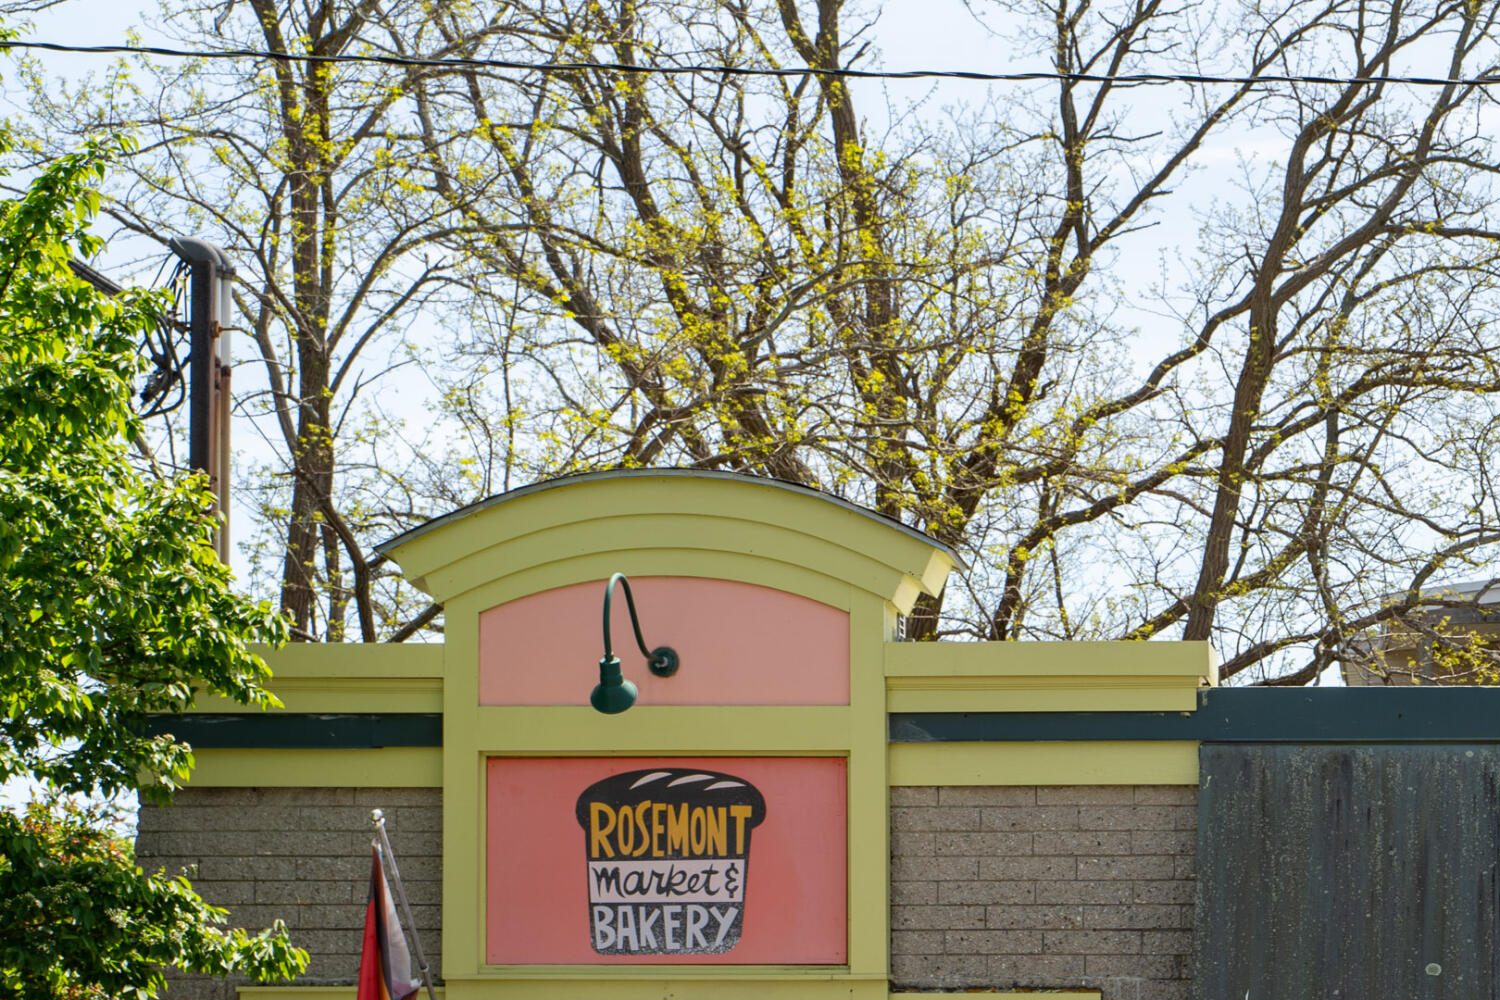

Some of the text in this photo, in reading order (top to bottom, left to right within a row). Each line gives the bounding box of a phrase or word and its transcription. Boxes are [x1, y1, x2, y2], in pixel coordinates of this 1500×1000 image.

[590, 800, 752, 858] ROSEMONT
[592, 862, 739, 898] Market &
[593, 905, 739, 950] BAKERY
